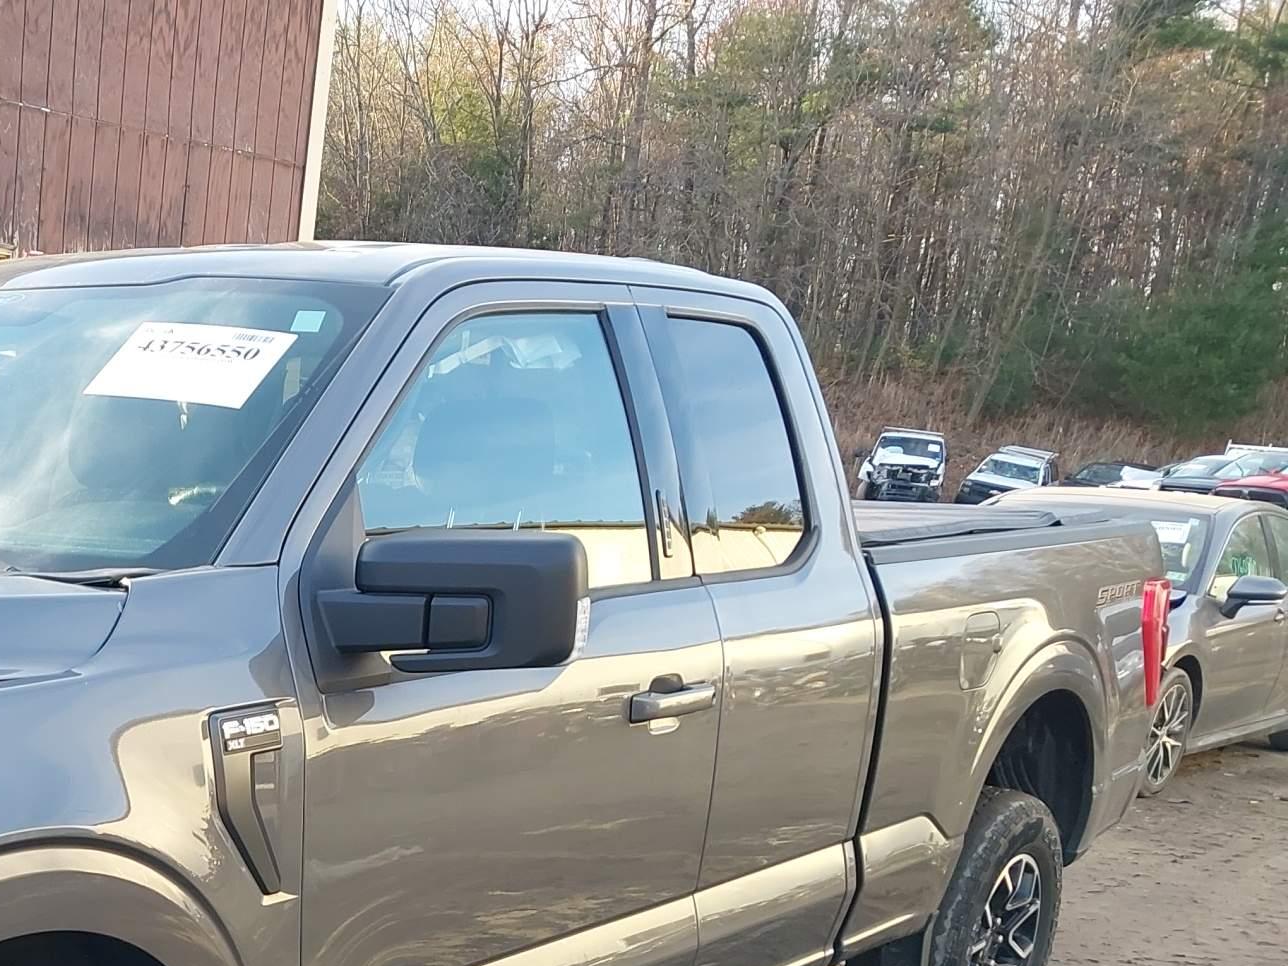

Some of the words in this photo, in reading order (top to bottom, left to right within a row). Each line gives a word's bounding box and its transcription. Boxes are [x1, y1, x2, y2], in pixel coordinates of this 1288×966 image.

[138, 339, 261, 361] 43756550
[1095, 580, 1141, 609] SPORT
[222, 713, 280, 740] F-150
[227, 738, 245, 751] XLT
